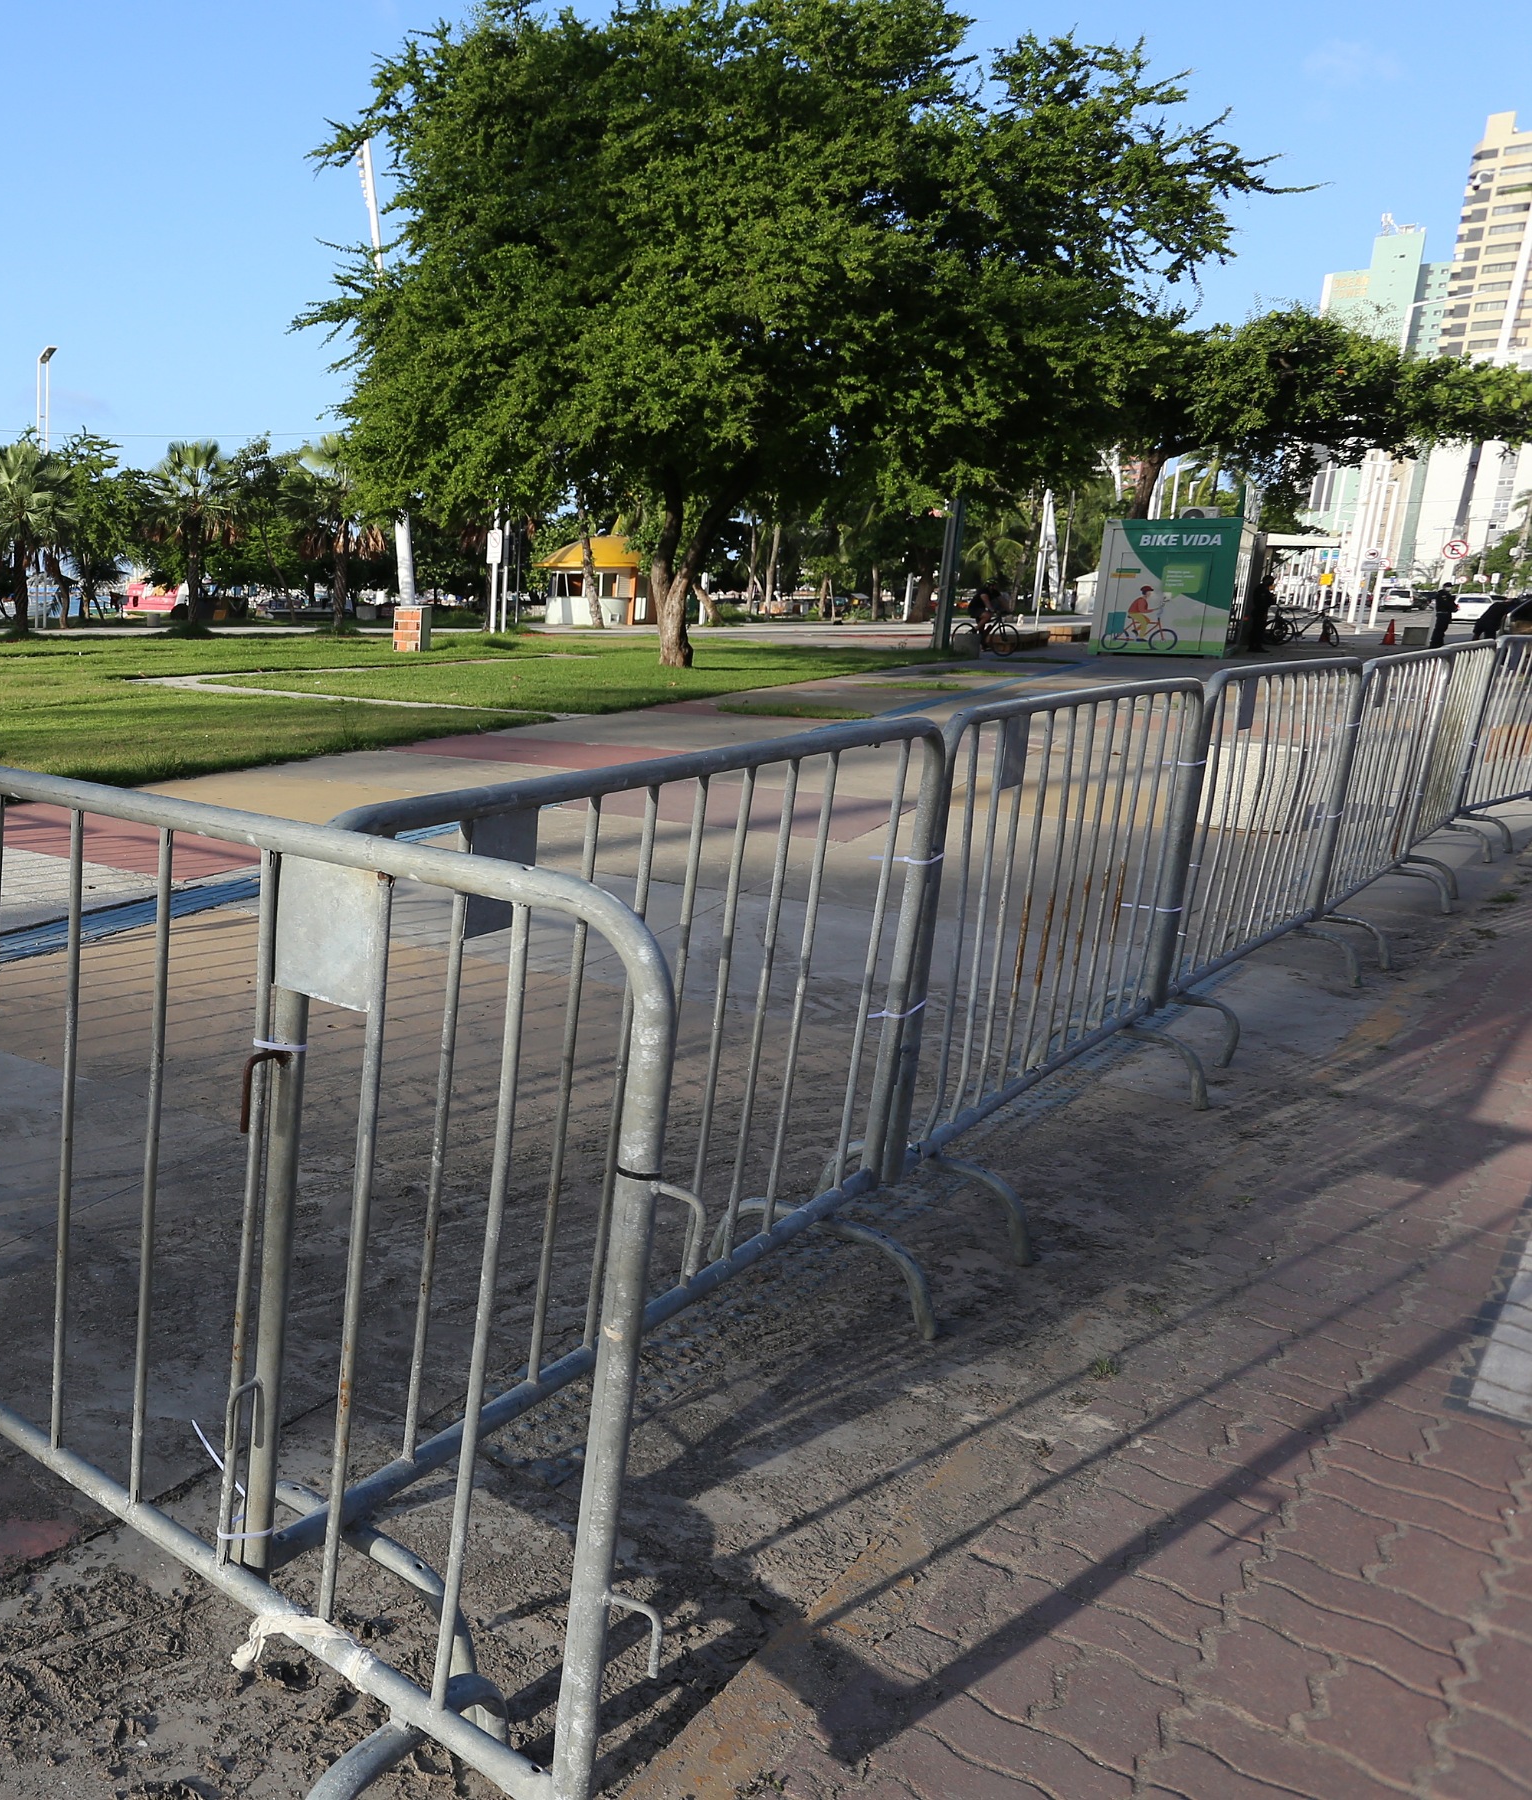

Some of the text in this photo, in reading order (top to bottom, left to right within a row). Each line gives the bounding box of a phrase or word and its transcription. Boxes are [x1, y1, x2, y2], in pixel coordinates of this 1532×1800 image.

[1333, 276, 1369, 288] OCEAN
[1333, 287, 1367, 299] TOWER
[1139, 534, 1222, 546] BIKE VIDA
[1450, 544, 1461, 555] E
